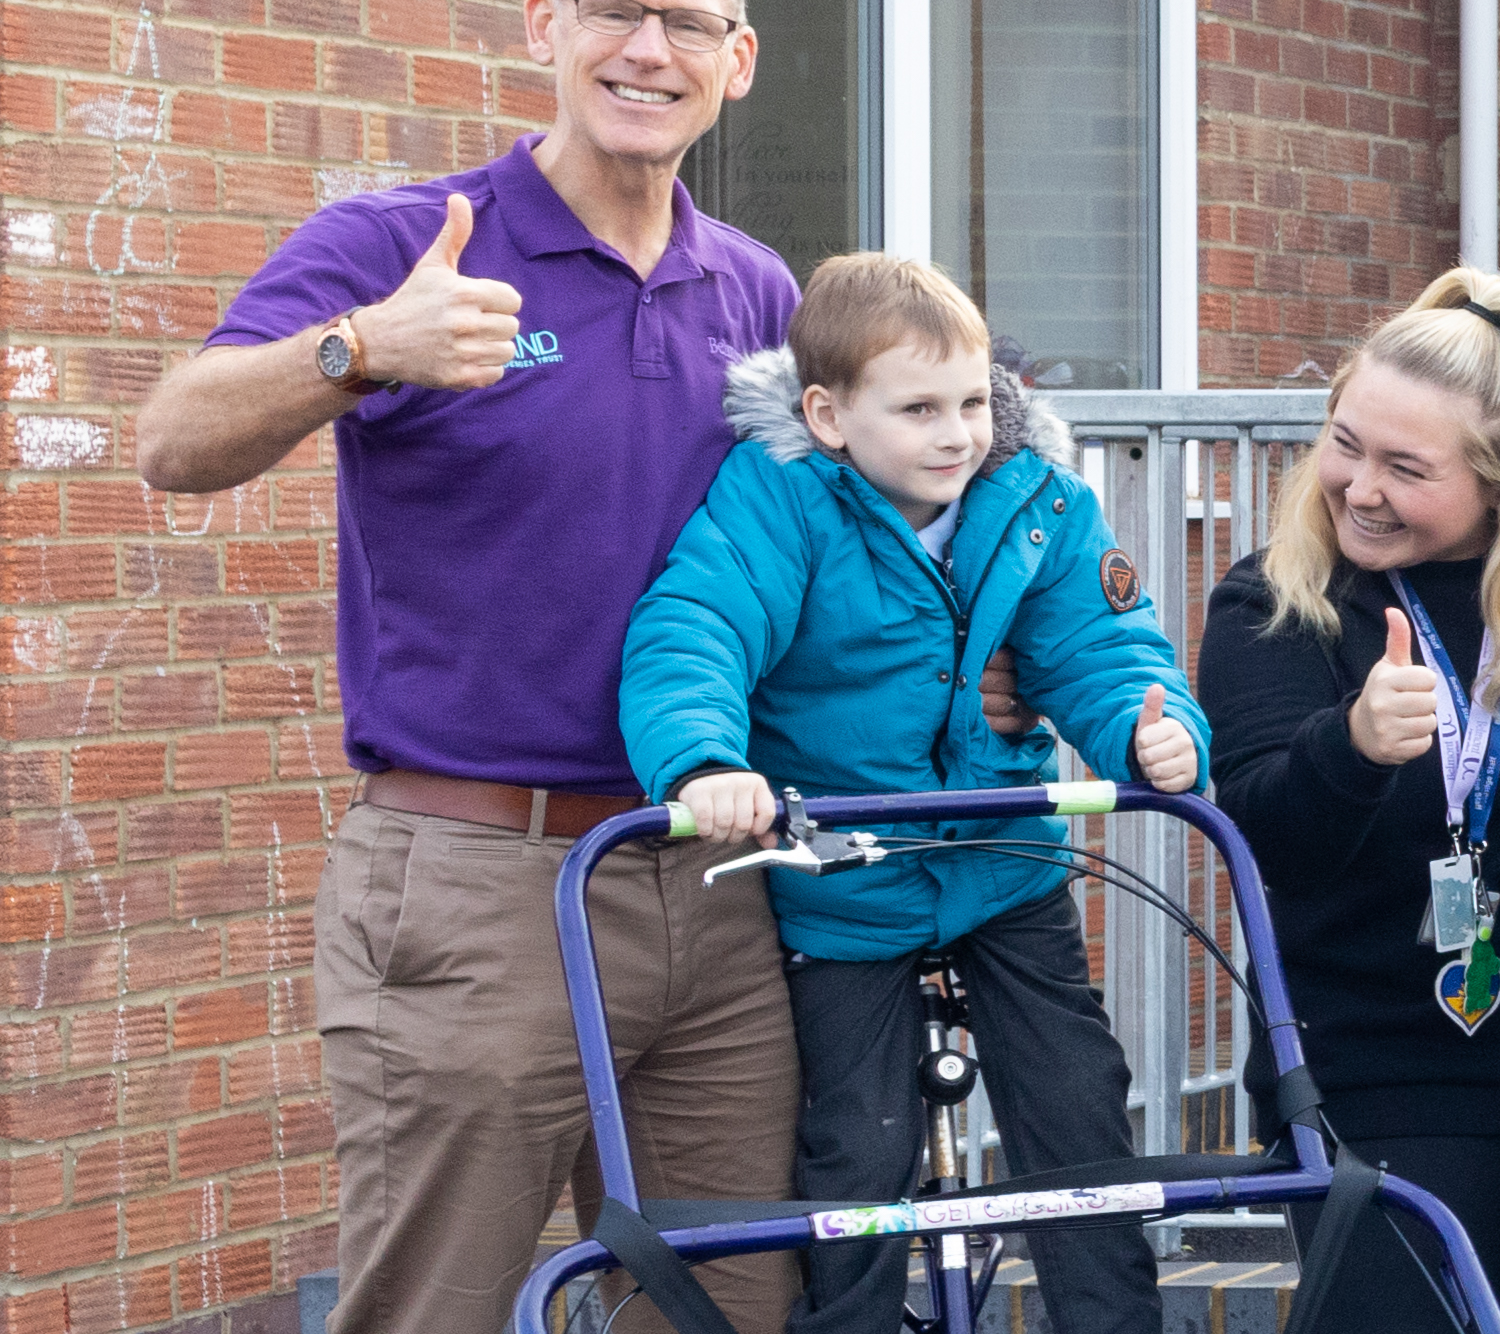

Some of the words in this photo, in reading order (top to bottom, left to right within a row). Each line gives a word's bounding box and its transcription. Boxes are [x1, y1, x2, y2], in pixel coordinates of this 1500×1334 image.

[514, 330, 558, 359] ND
[1427, 634, 1441, 649] Staff
[1445, 741, 1455, 780] Belmont
